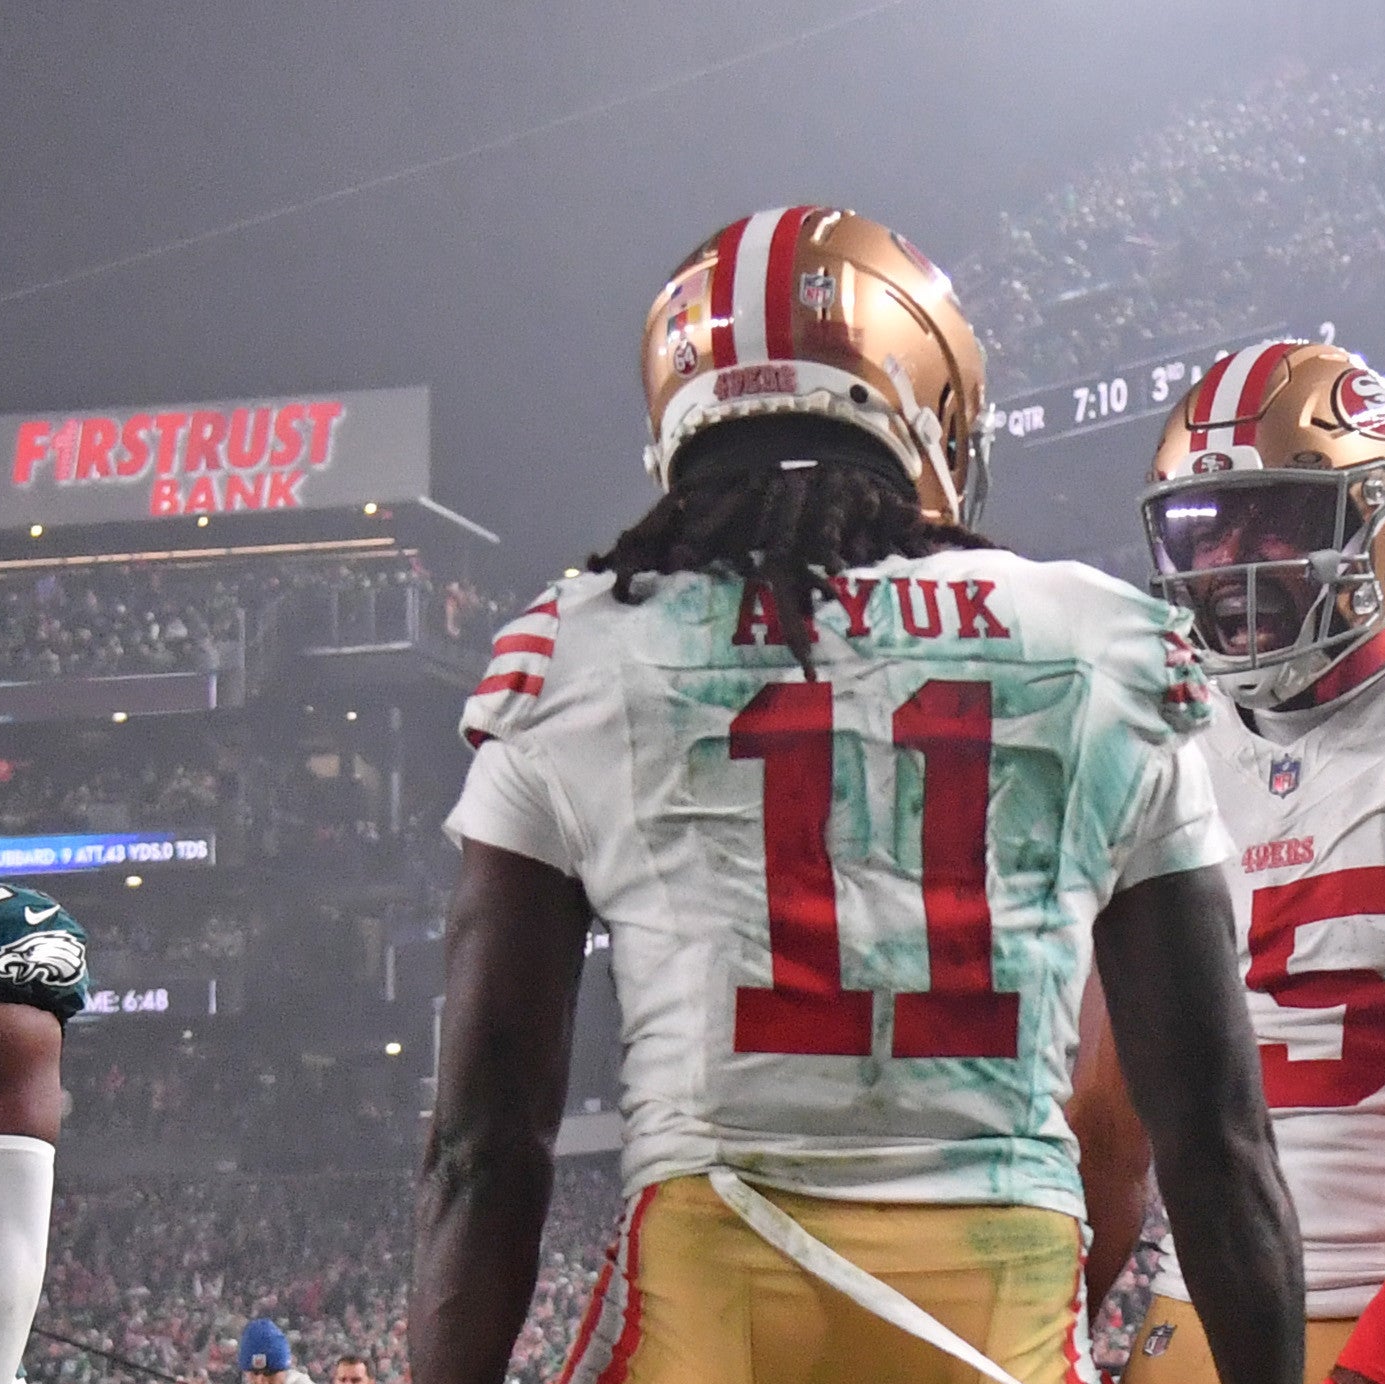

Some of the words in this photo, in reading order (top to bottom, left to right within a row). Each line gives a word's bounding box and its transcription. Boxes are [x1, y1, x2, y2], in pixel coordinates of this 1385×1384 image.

[1008, 405, 1045, 437] QTR
[1073, 378, 1128, 424] 7:10
[149, 470, 308, 518] BANK
[728, 679, 1020, 1059] 11
[1242, 836, 1315, 874] 49ERS
[122, 988, 170, 1012] 6:48
